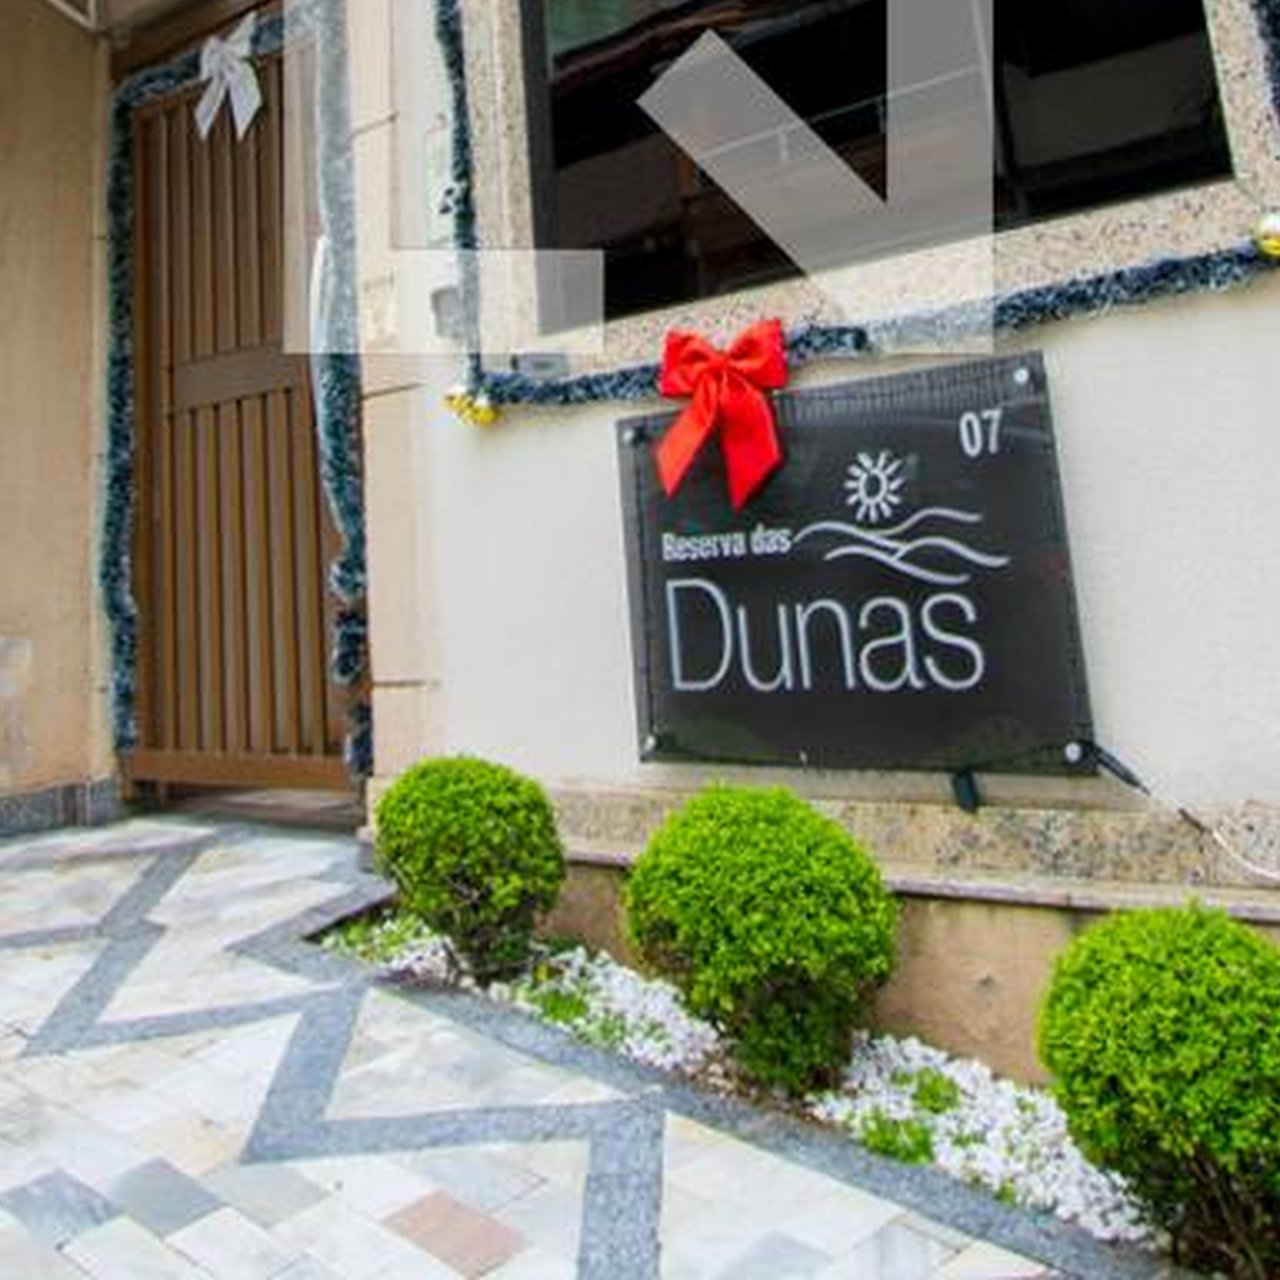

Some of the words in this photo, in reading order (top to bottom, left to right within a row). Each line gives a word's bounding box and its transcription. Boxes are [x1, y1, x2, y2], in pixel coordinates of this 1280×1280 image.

[959, 408, 1003, 458] 07
[661, 530, 747, 562] Reserva
[749, 521, 793, 556] das
[664, 577, 986, 692] Dunas
